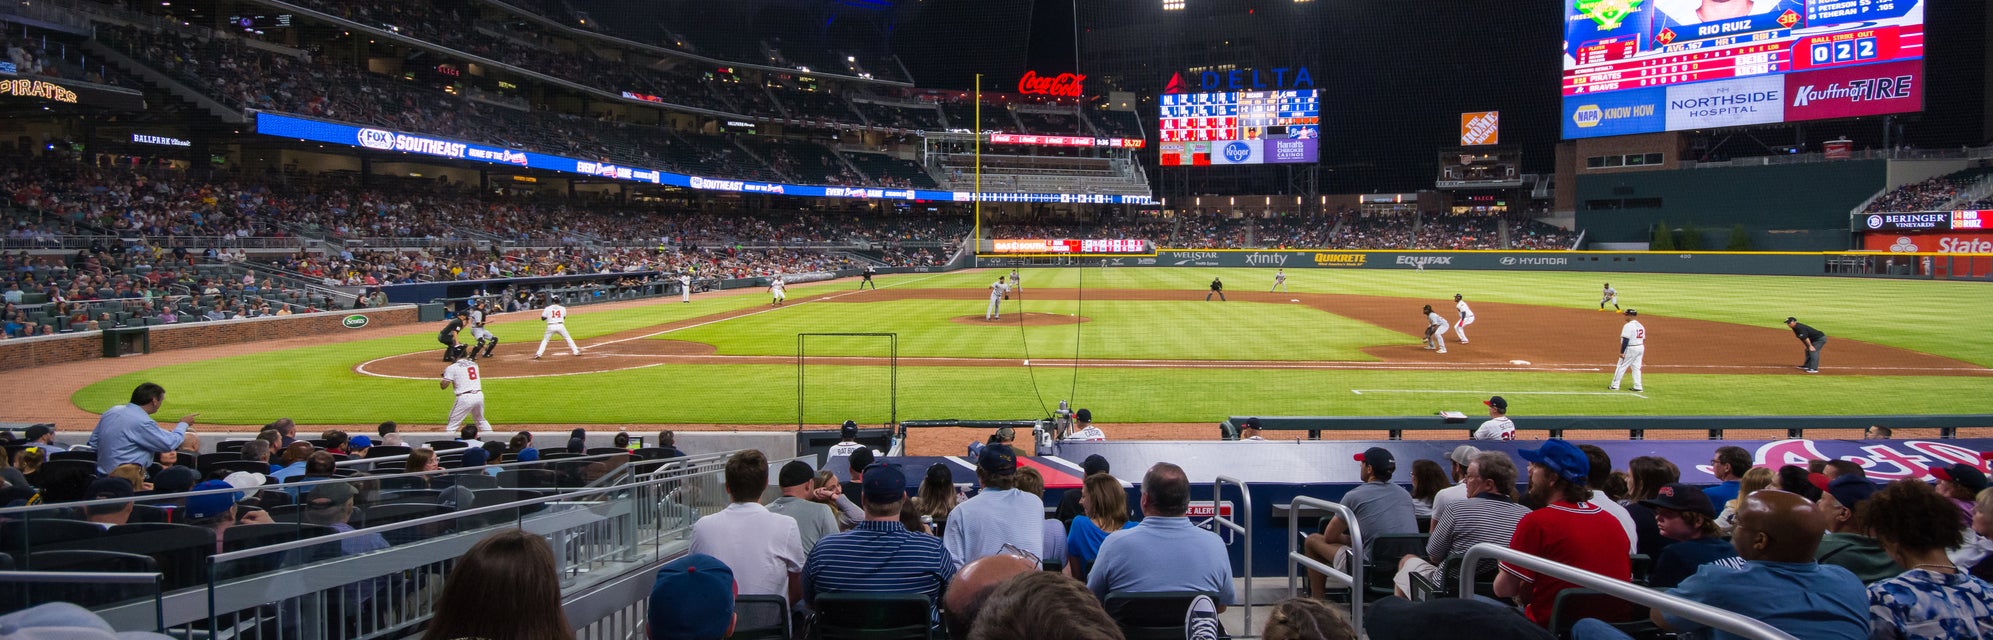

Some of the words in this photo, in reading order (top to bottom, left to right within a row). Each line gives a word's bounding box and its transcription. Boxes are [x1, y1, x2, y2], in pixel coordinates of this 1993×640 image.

[1818, 1, 1857, 12] PETERSON
[1818, 8, 1857, 19] TEHERAN
[1877, 3, 1894, 11] .105
[1782, 13, 1797, 24] 3B
[1698, 24, 1720, 36] RIO
[1722, 20, 1752, 32] RUIZ
[1857, 30, 1874, 38] OUT
[1659, 32, 1672, 41] 14
[1832, 33, 1854, 41] STRIKE
[1666, 45, 1685, 53] AVG
[1752, 33, 1769, 41] RBI
[1860, 41, 1874, 57] 2
[1814, 46, 1828, 62] 0
[1837, 43, 1851, 59] 2
[1018, 70, 1087, 96] Coca-Cola
[1202, 66, 1314, 90] DELTA
[1590, 73, 1621, 82] PIRATES
[0, 80, 78, 103] PIRATES
[1589, 83, 1619, 92] BRAVES
[1793, 84, 1868, 107] Kauffman
[1849, 75, 1912, 102] TIRE
[1163, 95, 1174, 105] NL
[1672, 91, 1779, 110] NORTHSIDE
[1577, 110, 1598, 122] NAPA
[1604, 108, 1631, 120] KNOW
[1633, 104, 1654, 116] HOW
[1690, 106, 1757, 117] HOSPITAL
[1164, 119, 1174, 129] AL
[1462, 111, 1498, 144] HOME
[1465, 116, 1480, 128] THE
[134, 134, 170, 145] BALLPARK
[366, 131, 387, 142] FOX
[1476, 123, 1497, 144] DEPOT
[395, 135, 467, 158] SOUTHEAST
[1226, 144, 1249, 161] Kroger
[576, 161, 596, 174] EVERY
[703, 178, 744, 191] SOUTHEAST
[825, 188, 845, 197] EVERY
[1886, 214, 1945, 223] BERINGER
[1963, 211, 1977, 219] RIO
[1963, 219, 1981, 228] RUIZ
[1937, 237, 1991, 254] State
[1173, 252, 1217, 260] WELLSTAR
[1245, 252, 1288, 266] xfinity
[1315, 253, 1366, 263] QUIKRETE
[1396, 255, 1452, 267] EQUIFAX
[551, 310, 561, 318] 14
[1636, 329, 1643, 339] 12
[467, 366, 477, 380] 8
[1194, 507, 1215, 515] ALERT
